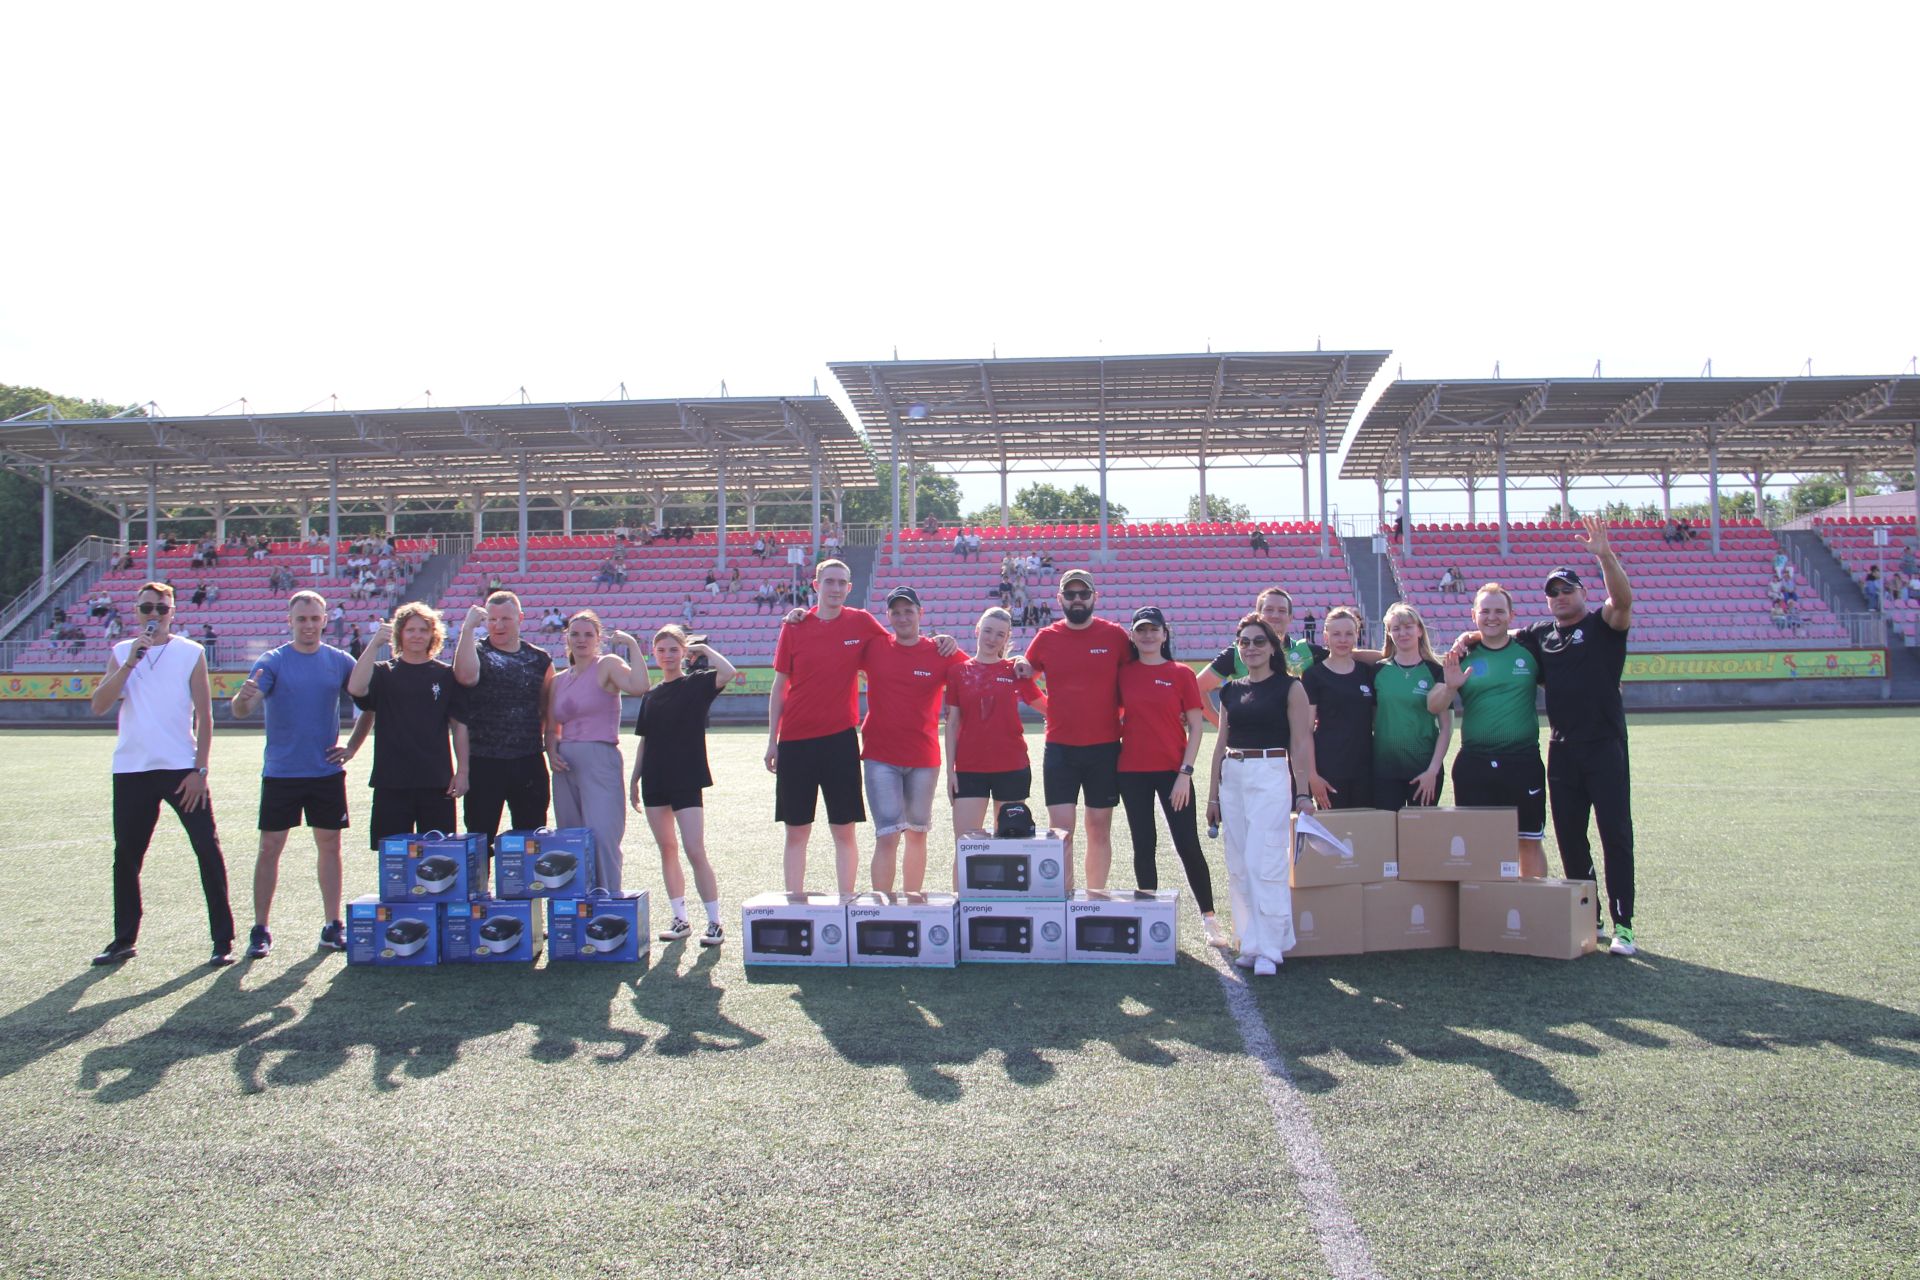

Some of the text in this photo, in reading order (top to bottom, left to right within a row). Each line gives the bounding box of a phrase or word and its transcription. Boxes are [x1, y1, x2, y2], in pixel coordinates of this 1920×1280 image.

[960, 843, 990, 851] gorenje
[746, 907, 774, 916] gorenje
[851, 909, 880, 917] gorenje
[962, 905, 992, 913] gorenje
[1070, 905, 1101, 913] gorenje
